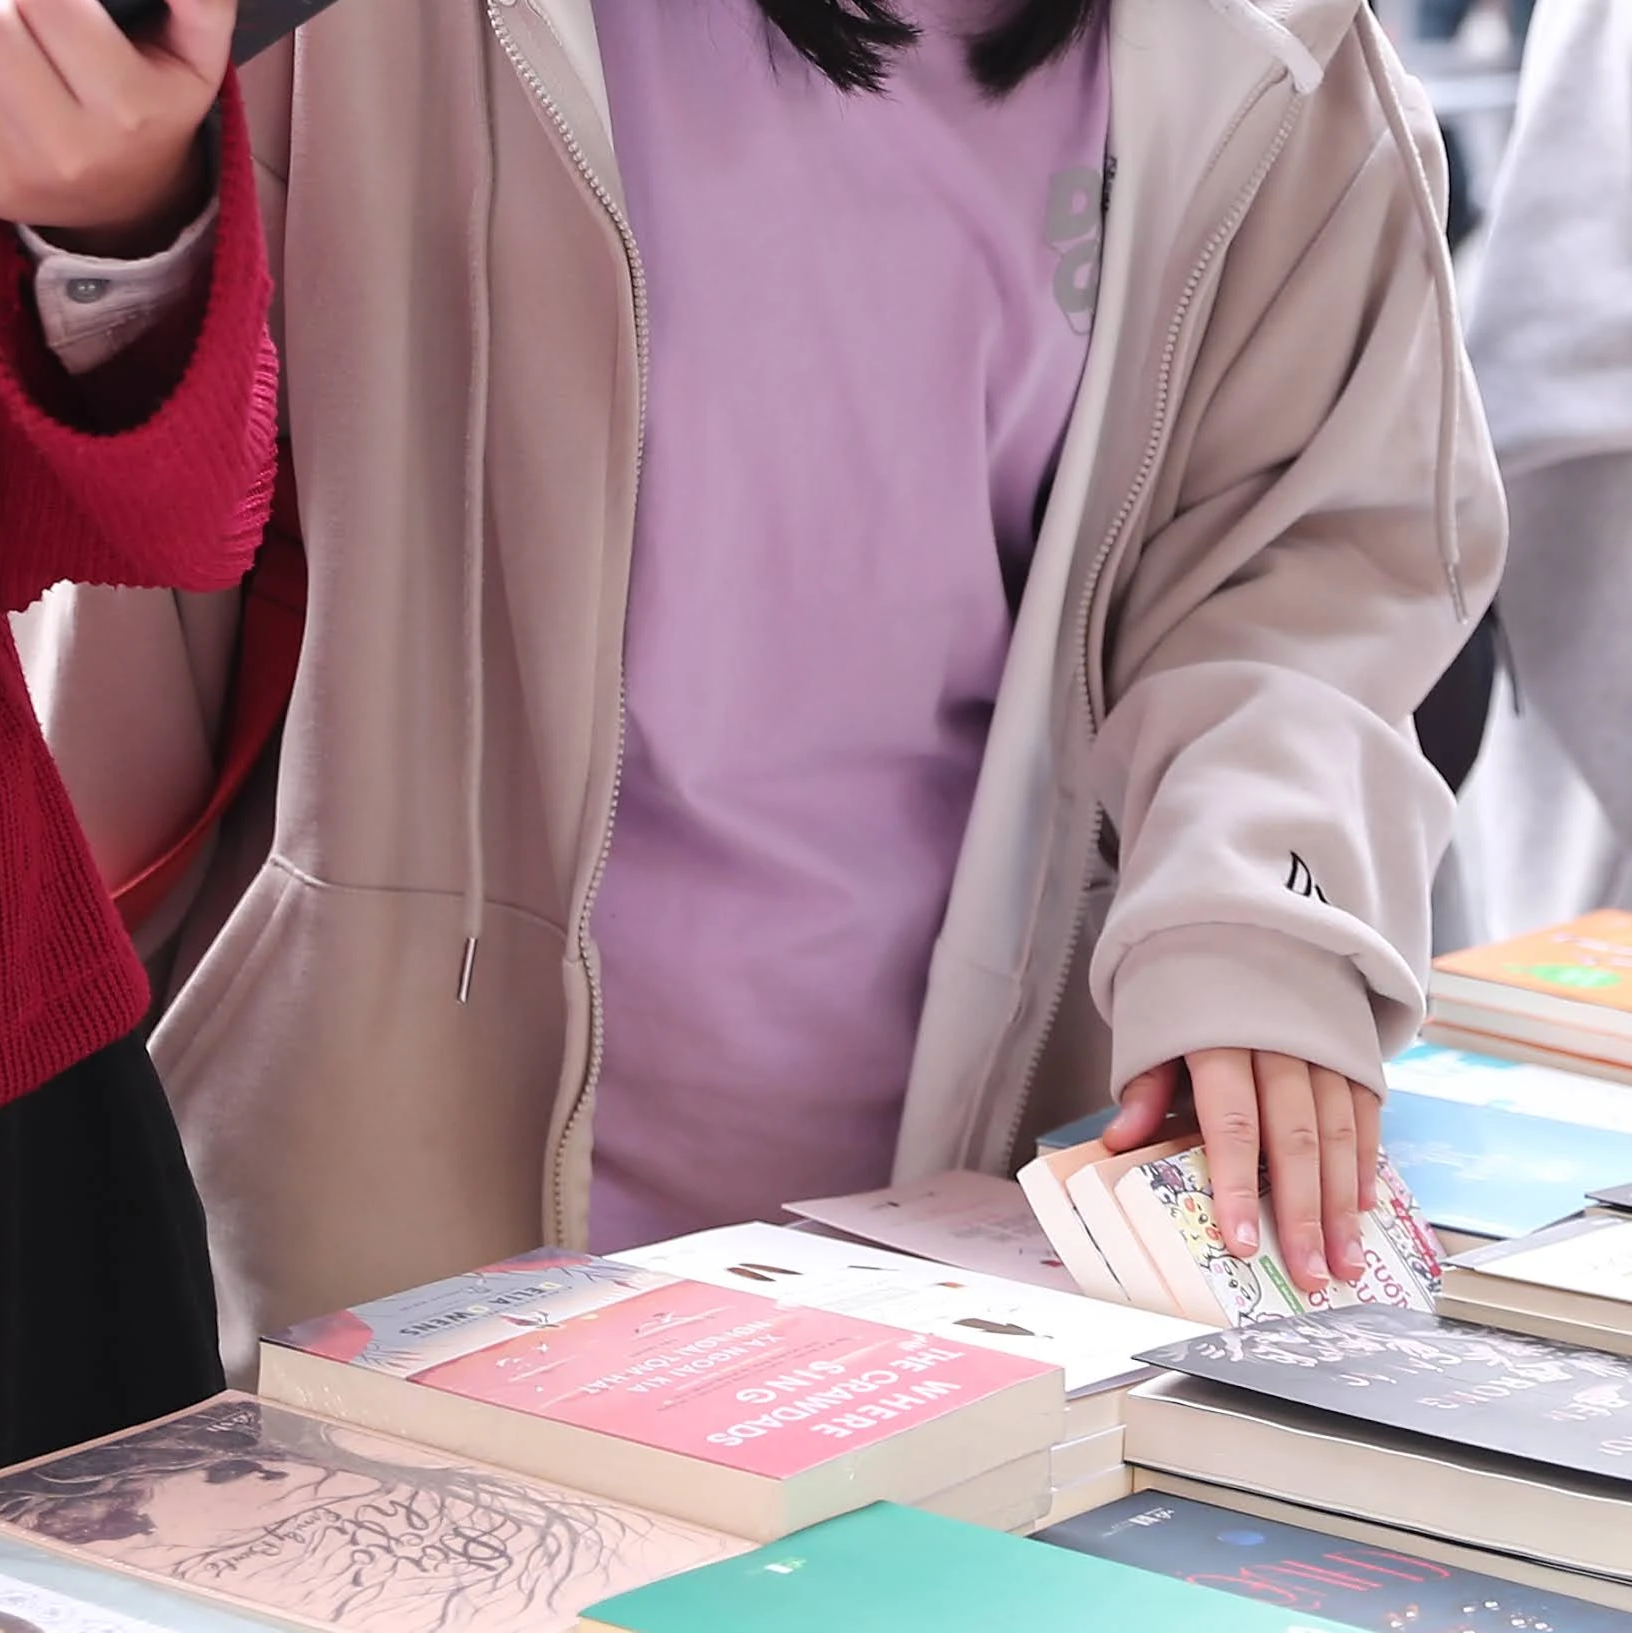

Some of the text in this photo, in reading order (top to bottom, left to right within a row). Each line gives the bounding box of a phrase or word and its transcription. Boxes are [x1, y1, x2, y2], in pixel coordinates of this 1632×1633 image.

[398, 1281, 563, 1336] DELIA OWENS
[705, 1347, 964, 1447] THE CRAWDADS
[735, 1360, 846, 1404] SING
[808, 1380, 962, 1439] WHERE
